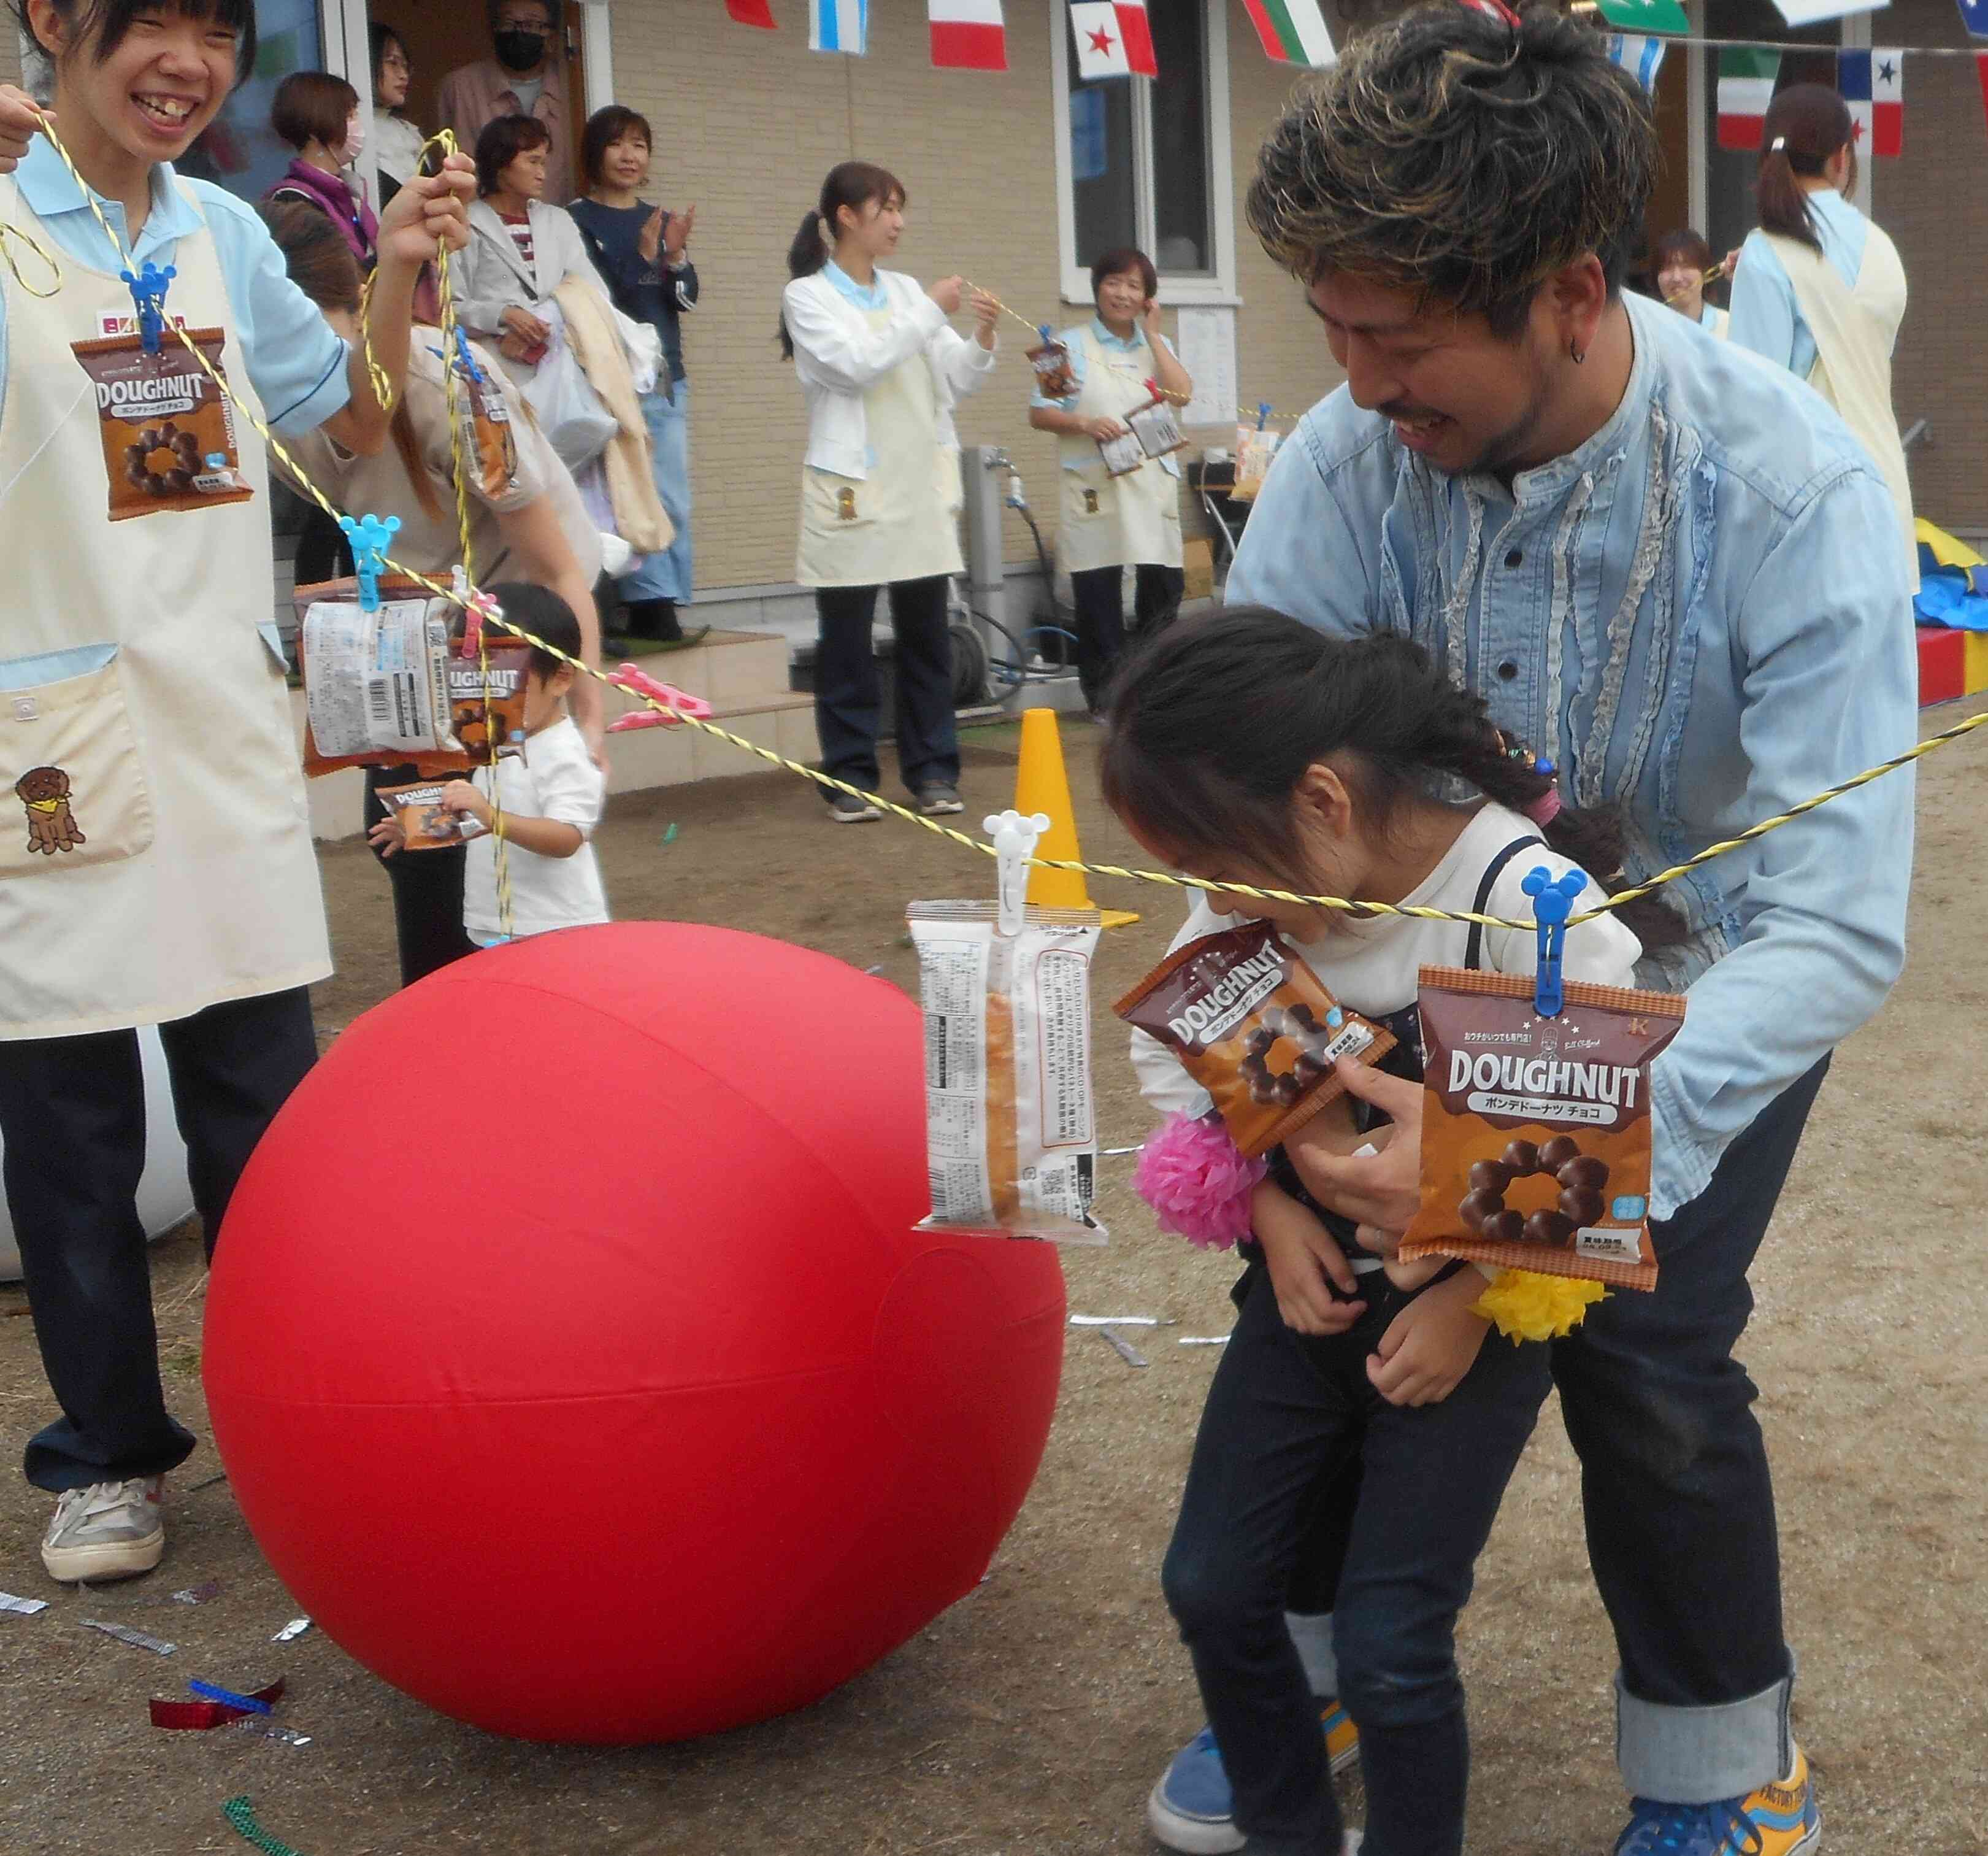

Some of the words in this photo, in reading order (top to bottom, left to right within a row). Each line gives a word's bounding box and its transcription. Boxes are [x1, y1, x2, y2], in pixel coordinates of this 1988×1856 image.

[96, 373, 204, 409] DOUGHNUT
[450, 669, 519, 689] UGHNUT
[395, 787, 442, 804] DOUGH
[1167, 939, 1286, 1045] DOUGHNUT
[1211, 995, 1253, 1035] ポンデドーナツ
[1253, 978, 1274, 998] チョコ
[1448, 1049, 1640, 1108] DOUGHNUT
[1485, 1097, 1564, 1117] ポンデドーナツ
[1568, 1105, 1600, 1119] チョコ
